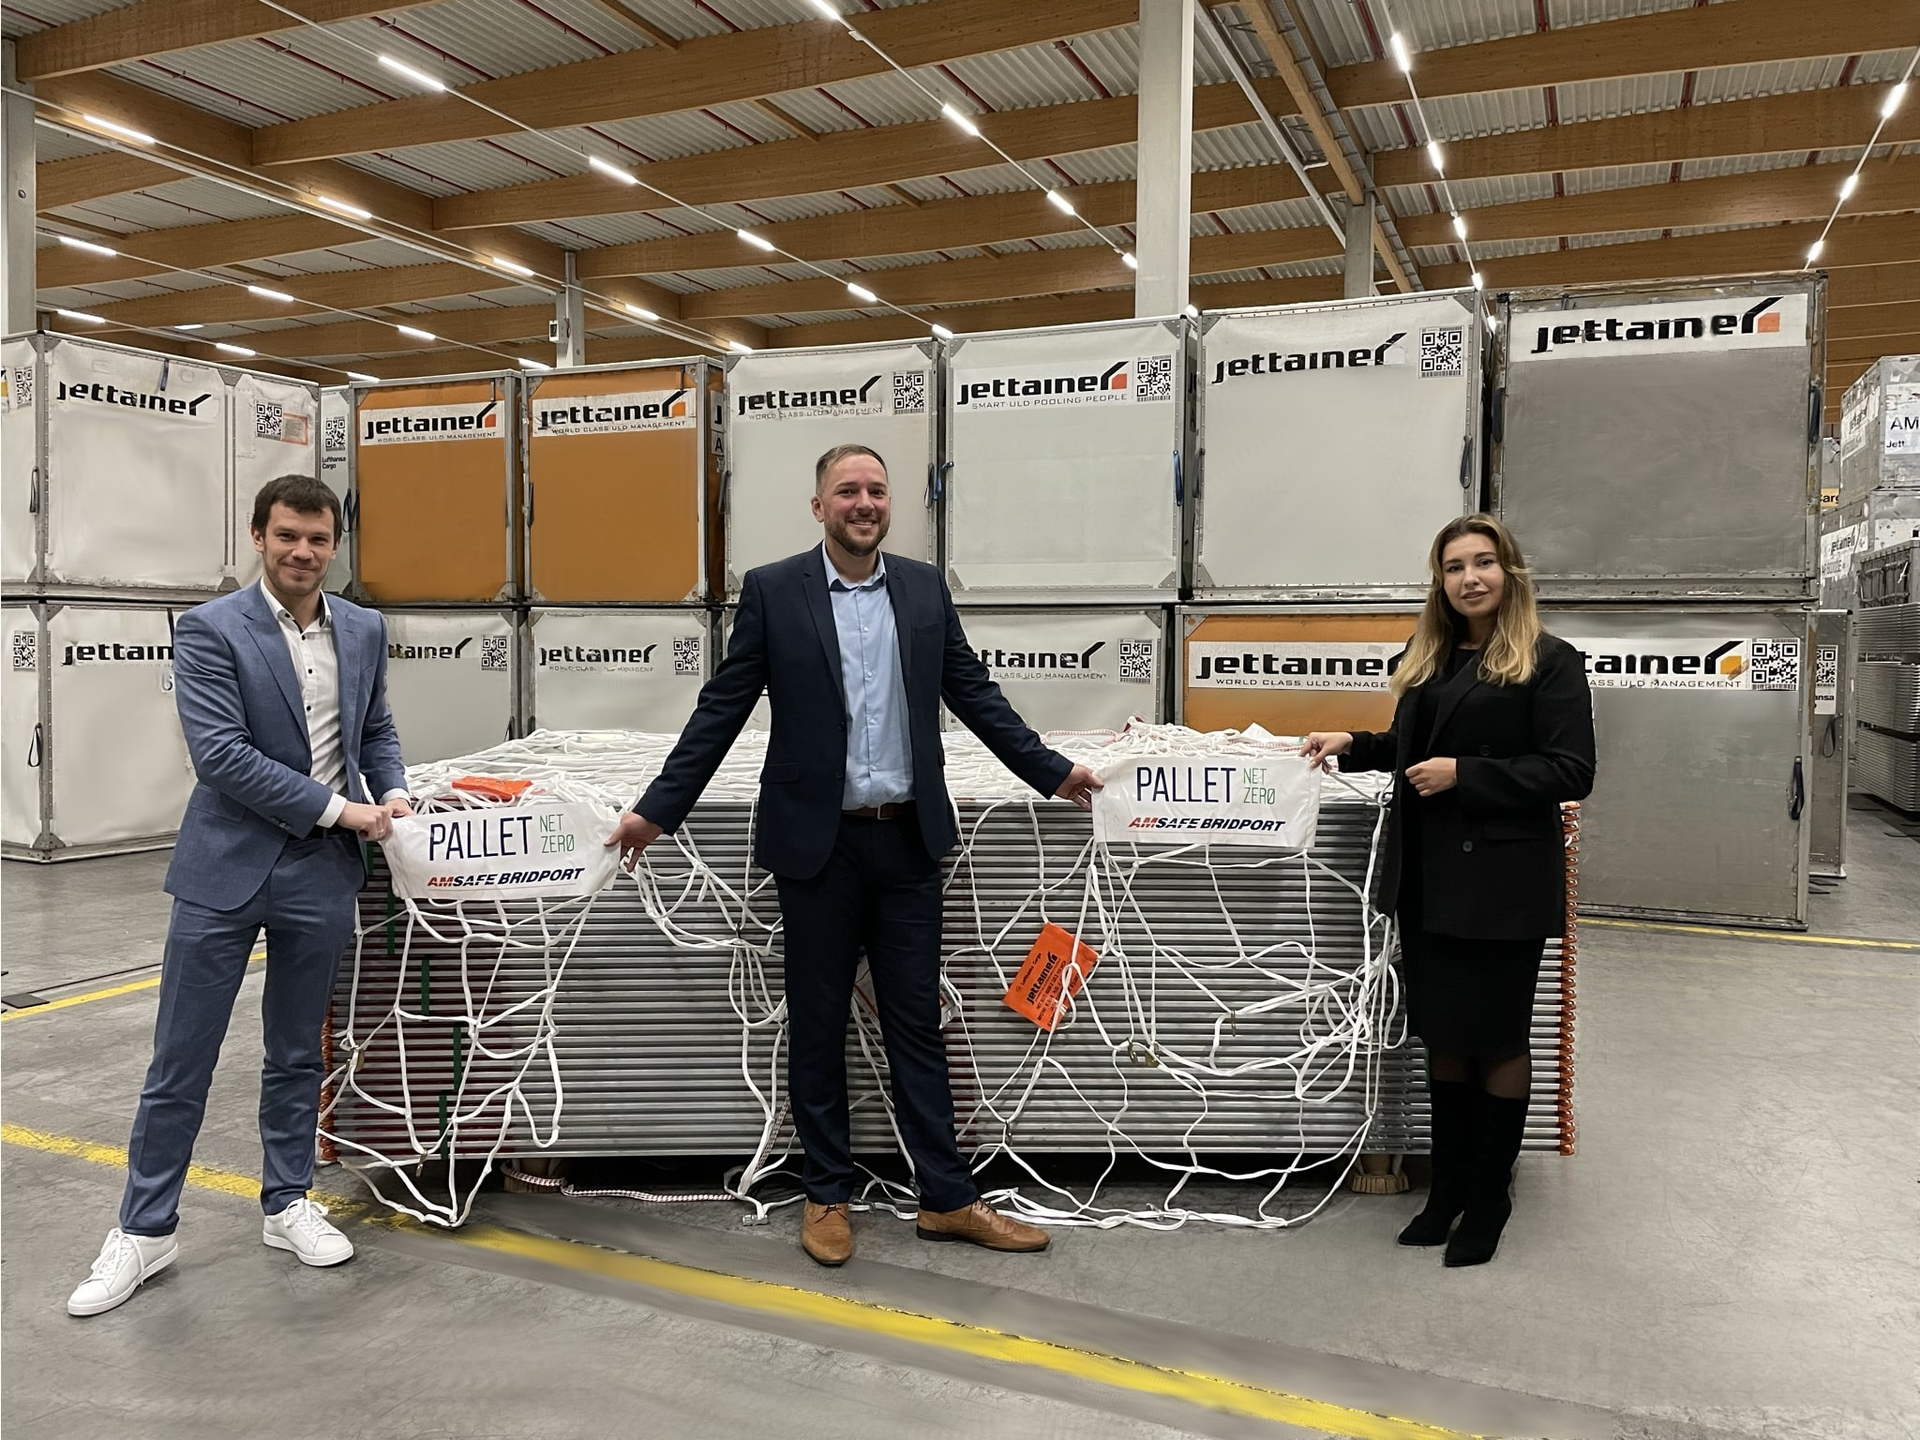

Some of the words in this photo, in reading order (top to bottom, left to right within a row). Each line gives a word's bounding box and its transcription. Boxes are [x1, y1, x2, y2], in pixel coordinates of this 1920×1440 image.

[1531, 297, 1784, 354] jettainer
[1211, 332, 1407, 384] jettainer
[56, 381, 212, 416] jettainer
[738, 375, 882, 415] jettainer
[957, 361, 1129, 406] jettainer
[365, 402, 498, 440] jettainer
[538, 390, 688, 431] jettainer
[630, 420, 686, 429] MANAGEMENT
[539, 644, 658, 666] jettainer
[975, 642, 1105, 668] ttainer
[1216, 678, 1258, 686] WORLD
[1262, 679, 1302, 687] CLASS
[1306, 680, 1331, 688] ULD
[1620, 680, 1646, 688] ULD
[1650, 679, 1742, 688] MANAGEMENT
[1136, 766, 1237, 804] PALLET
[1243, 767, 1268, 785] NET
[429, 816, 533, 862] PALLET
[540, 814, 565, 833] NET
[1128, 816, 1201, 830] AMSAFE
[1199, 818, 1286, 832] BRIDPORT
[427, 873, 498, 887] AMSAFE
[497, 867, 586, 886] BRIDPORT
[1026, 950, 1056, 1005] jettainer
